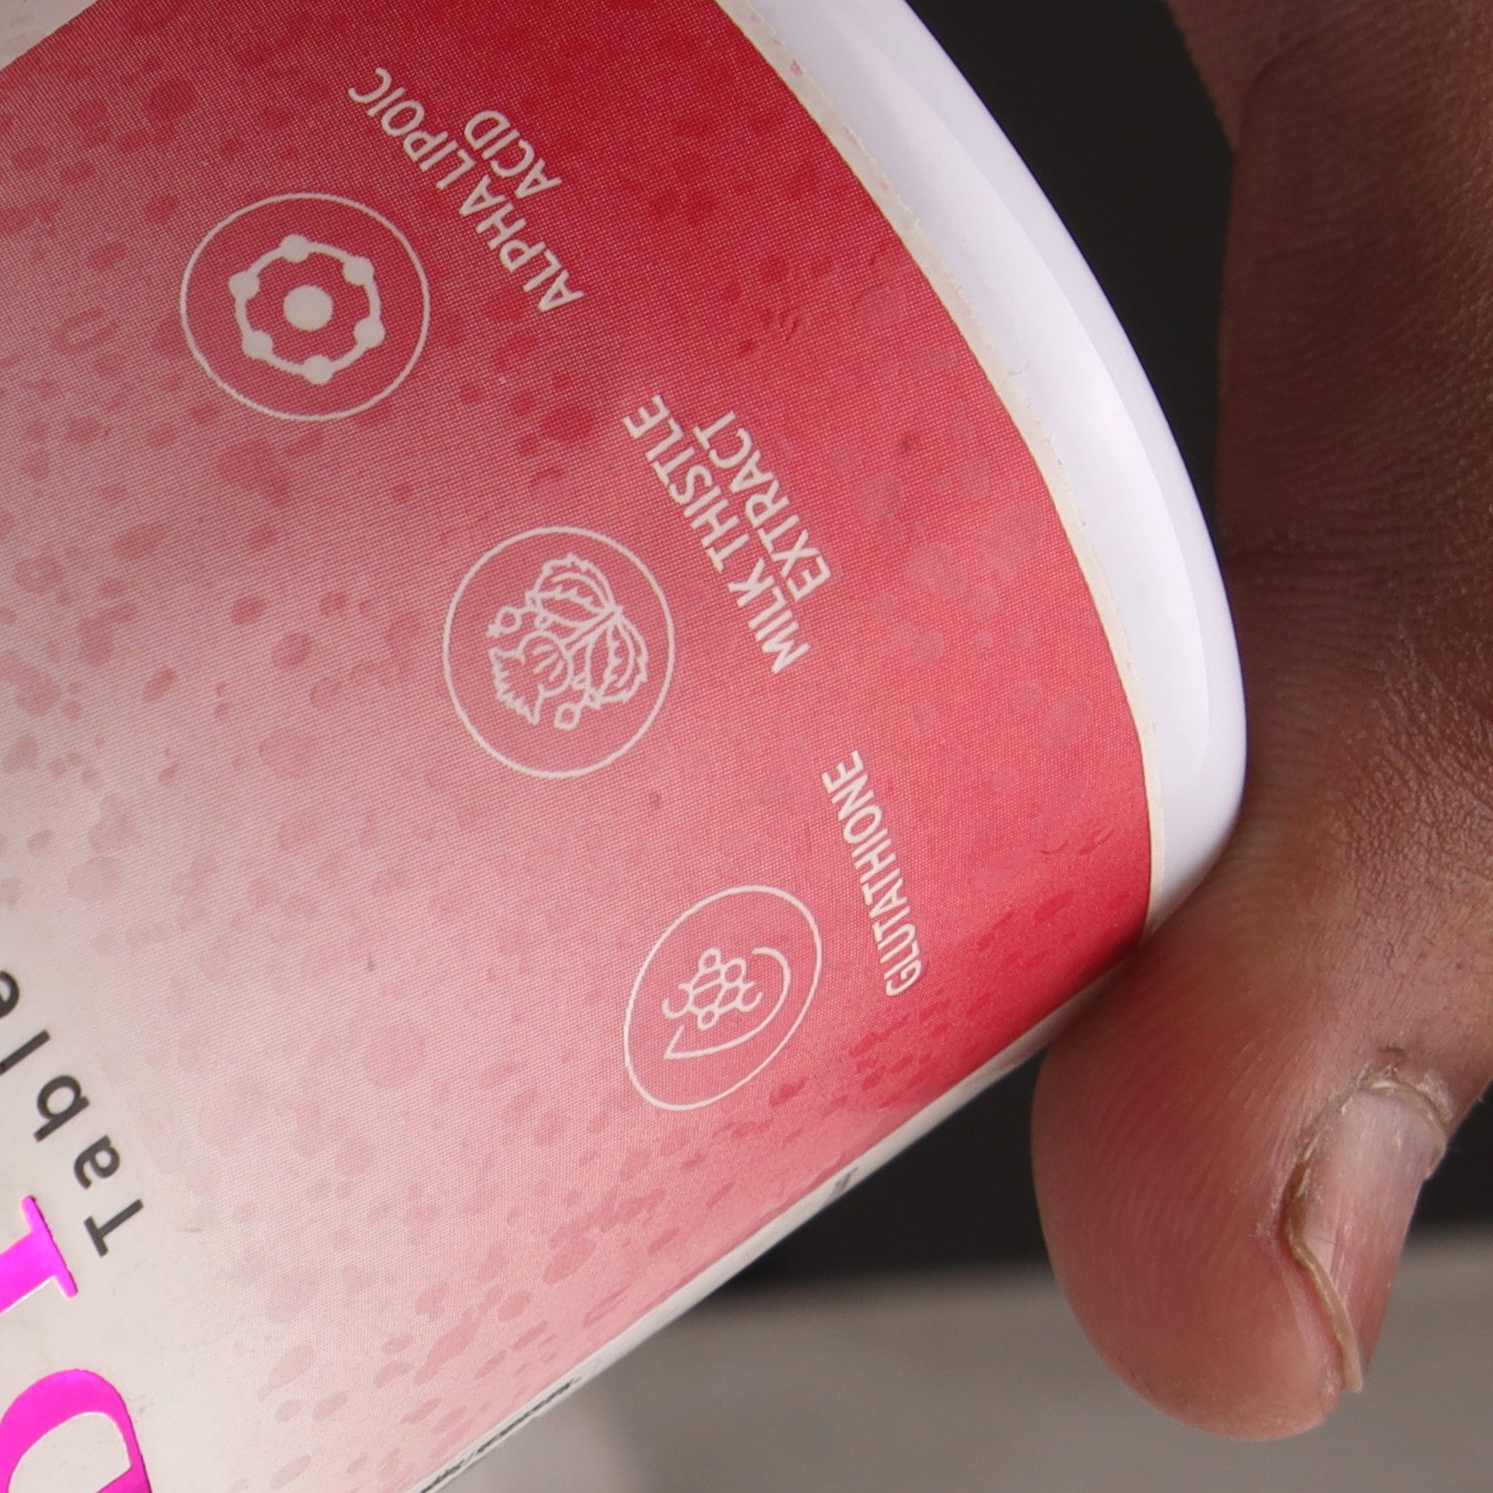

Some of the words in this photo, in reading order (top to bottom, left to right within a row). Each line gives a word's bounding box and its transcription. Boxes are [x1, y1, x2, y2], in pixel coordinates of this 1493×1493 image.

[347, 66, 472, 191] LIPOIC
[465, 110, 562, 198] ACID
[458, 172, 584, 312] ALPHA
[622, 394, 747, 571] THISTLE
[693, 411, 832, 602] EXTRACT
[726, 557, 811, 674] MILK
[821, 750, 923, 997] GLUTATHIONE
